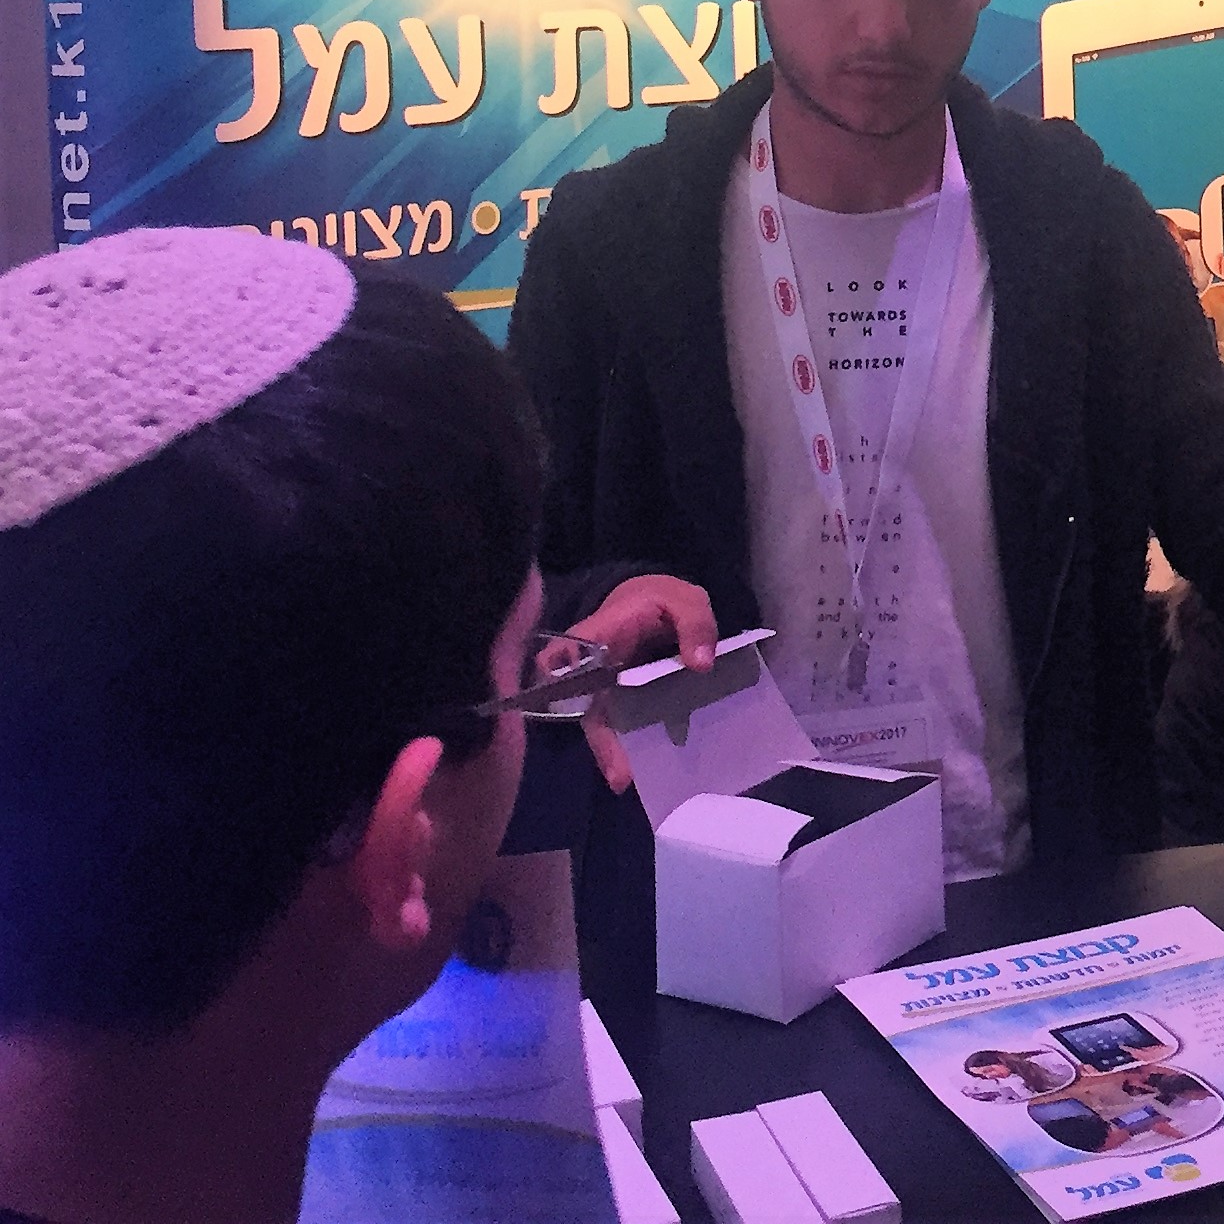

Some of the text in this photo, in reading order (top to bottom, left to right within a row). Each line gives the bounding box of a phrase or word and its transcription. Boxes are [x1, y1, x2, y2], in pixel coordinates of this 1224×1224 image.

[827, 279, 908, 293] LOOK
[827, 309, 907, 323] TOWARDS
[828, 325, 907, 337] THE
[828, 357, 905, 371] HORIZON
[905, 933, 1140, 990] קבוצת עמל
[1065, 1175, 1141, 1203] עמל
